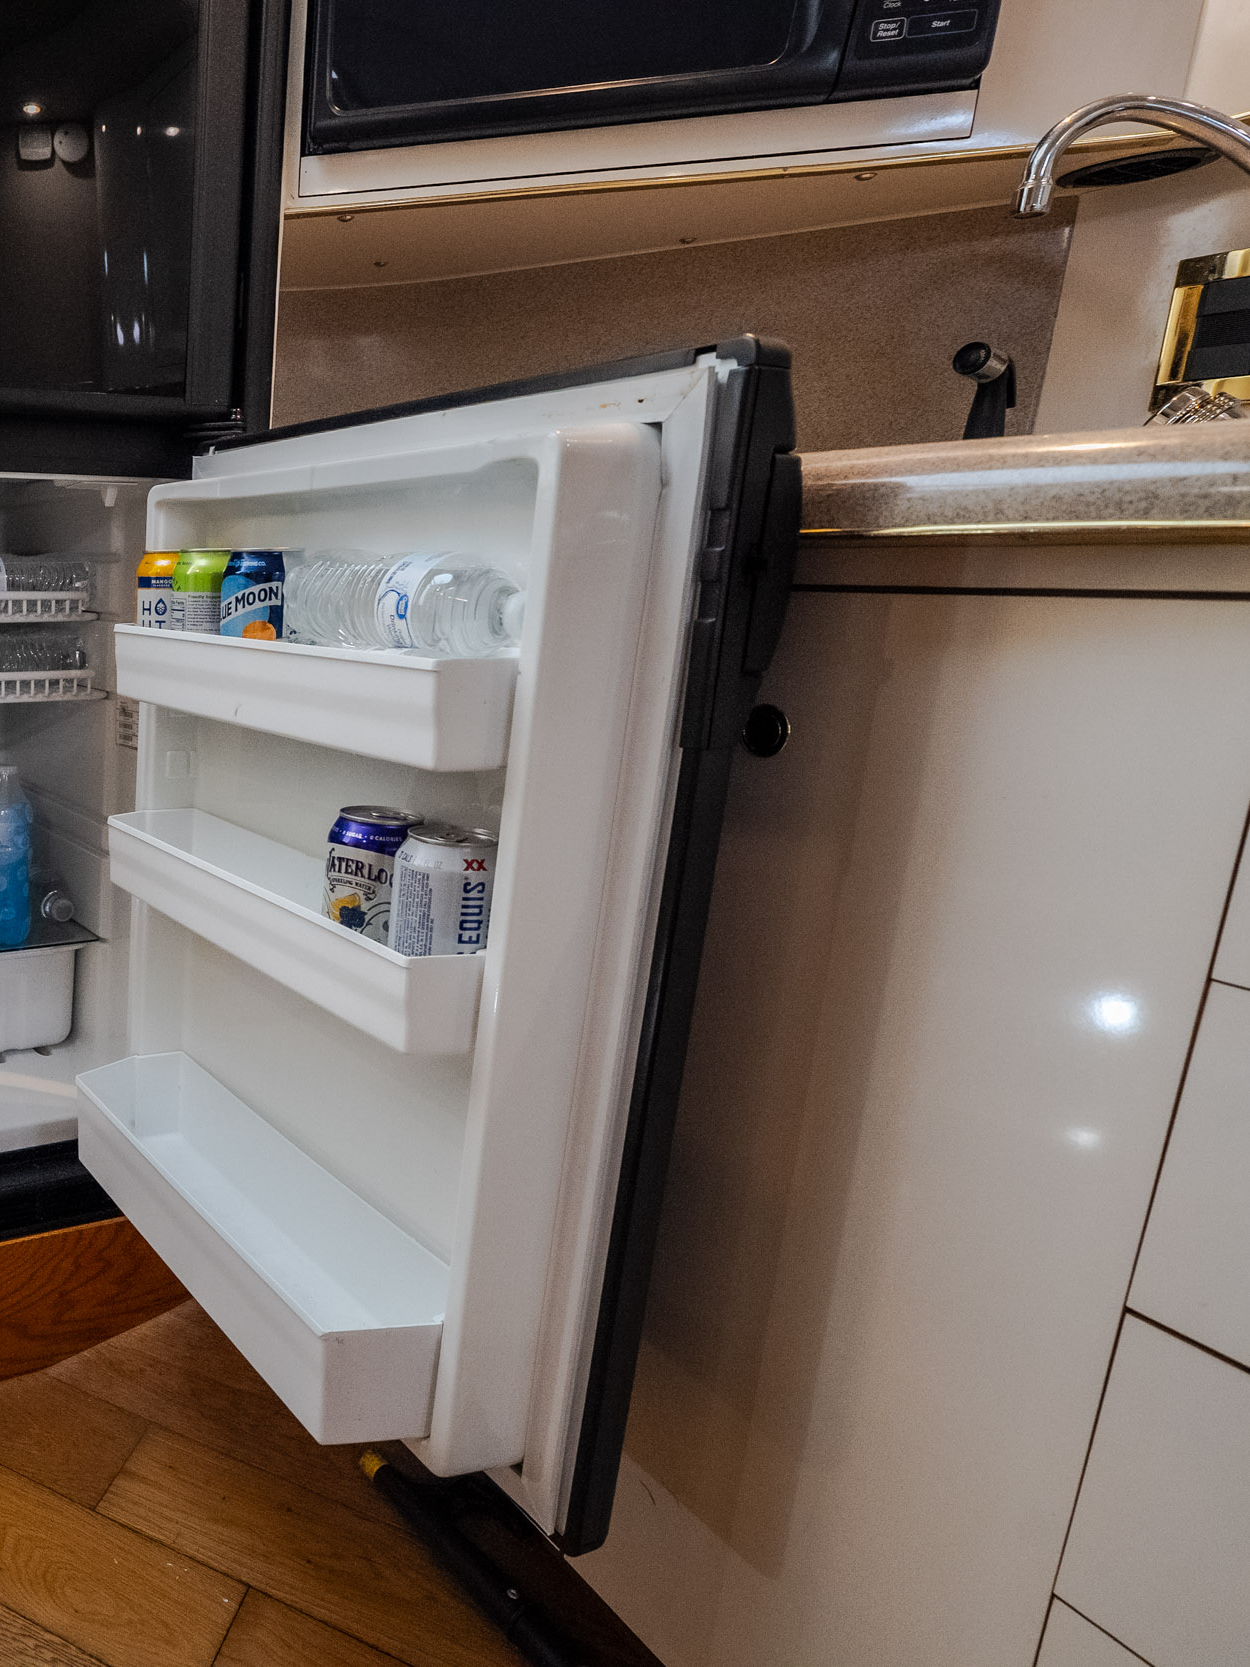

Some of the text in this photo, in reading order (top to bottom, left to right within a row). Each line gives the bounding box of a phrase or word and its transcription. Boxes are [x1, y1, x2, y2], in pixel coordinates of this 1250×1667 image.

[878, 21, 901, 31] Stop/
[931, 20, 951, 28] Start
[876, 29, 899, 37] Reset
[234, 585, 280, 613] MOON
[463, 858, 488, 872] XX
[354, 881, 372, 892] WATER
[457, 881, 487, 945] EQUIS
